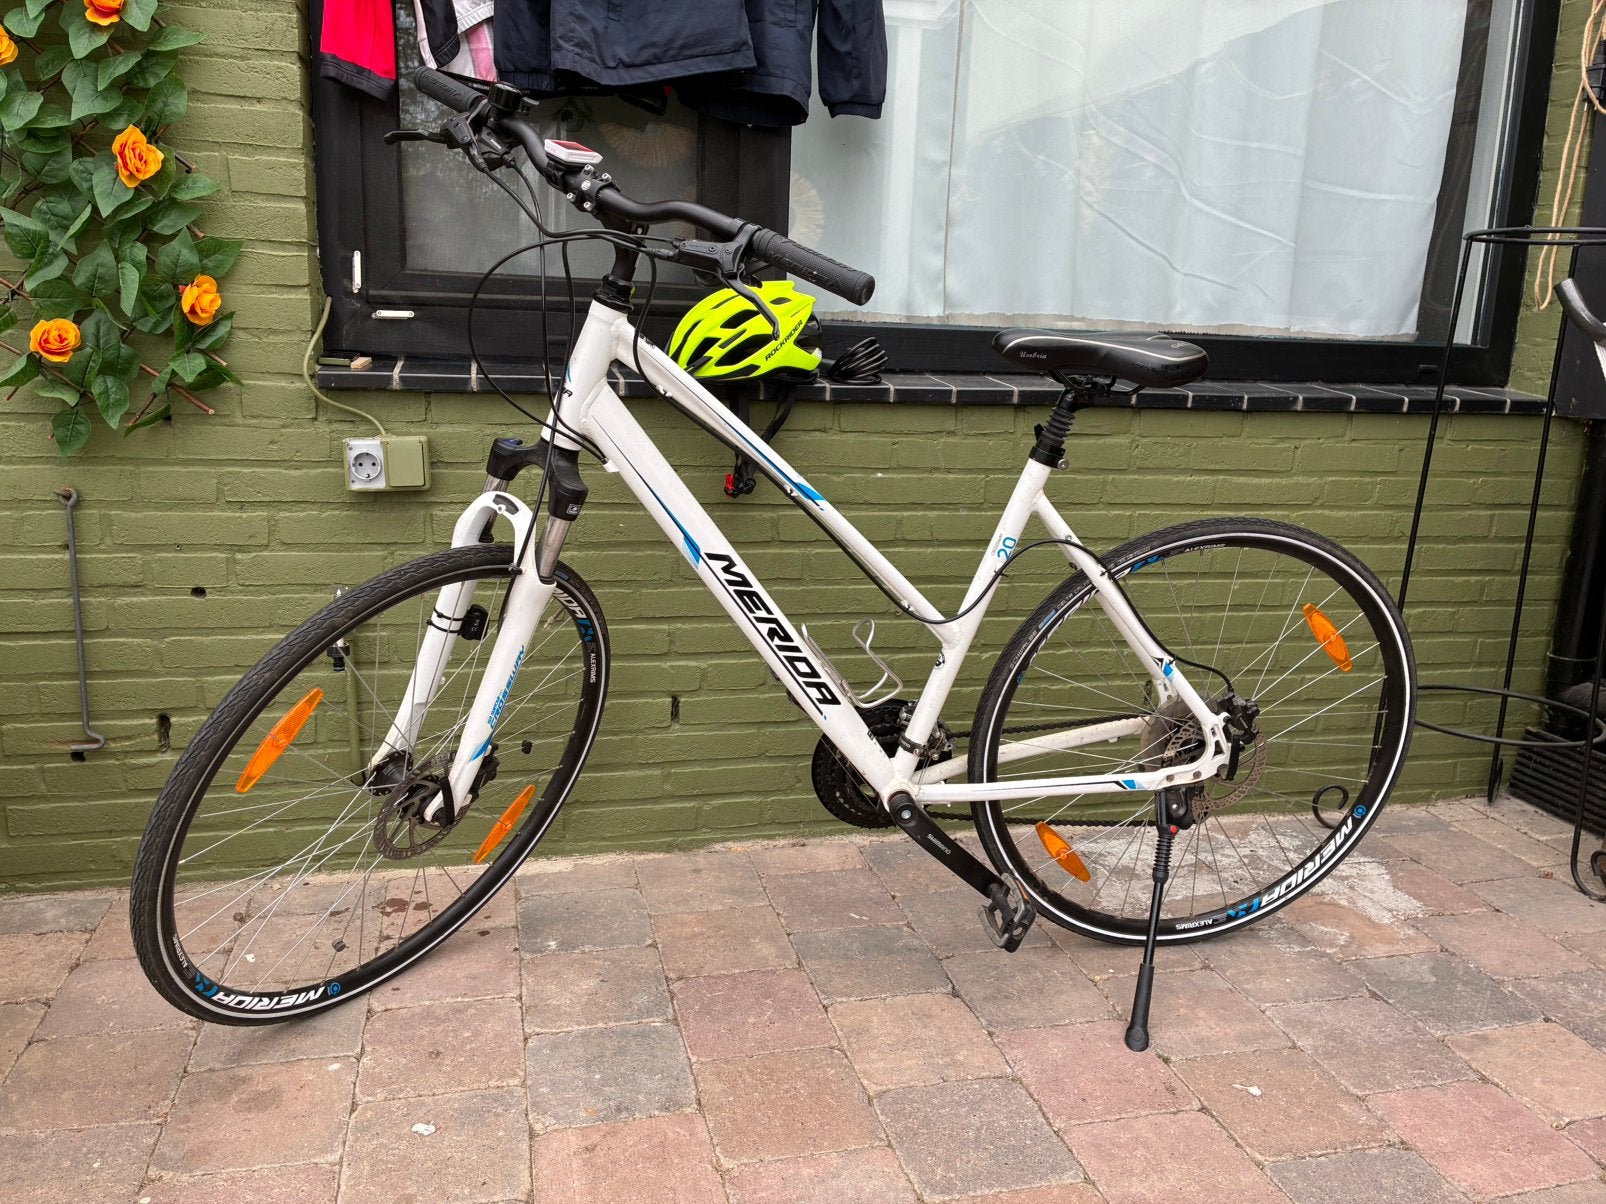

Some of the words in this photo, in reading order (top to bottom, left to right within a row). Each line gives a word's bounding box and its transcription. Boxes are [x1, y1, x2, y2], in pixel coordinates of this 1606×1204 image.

[765, 319, 804, 362] ROCKRIDER
[1018, 350, 1048, 359] Umbria
[997, 536, 1017, 561] 20
[704, 552, 842, 706] MERIDA
[1009, 629, 1038, 670] SCHWALBE
[589, 652, 597, 683] ALEXRIMS
[927, 833, 951, 855] SHIMANO
[1261, 816, 1353, 908] MERIDA
[1176, 917, 1213, 930] ALEXRIMS
[172, 934, 188, 969] ALEXRIMS
[212, 986, 326, 1010] MERIDA
